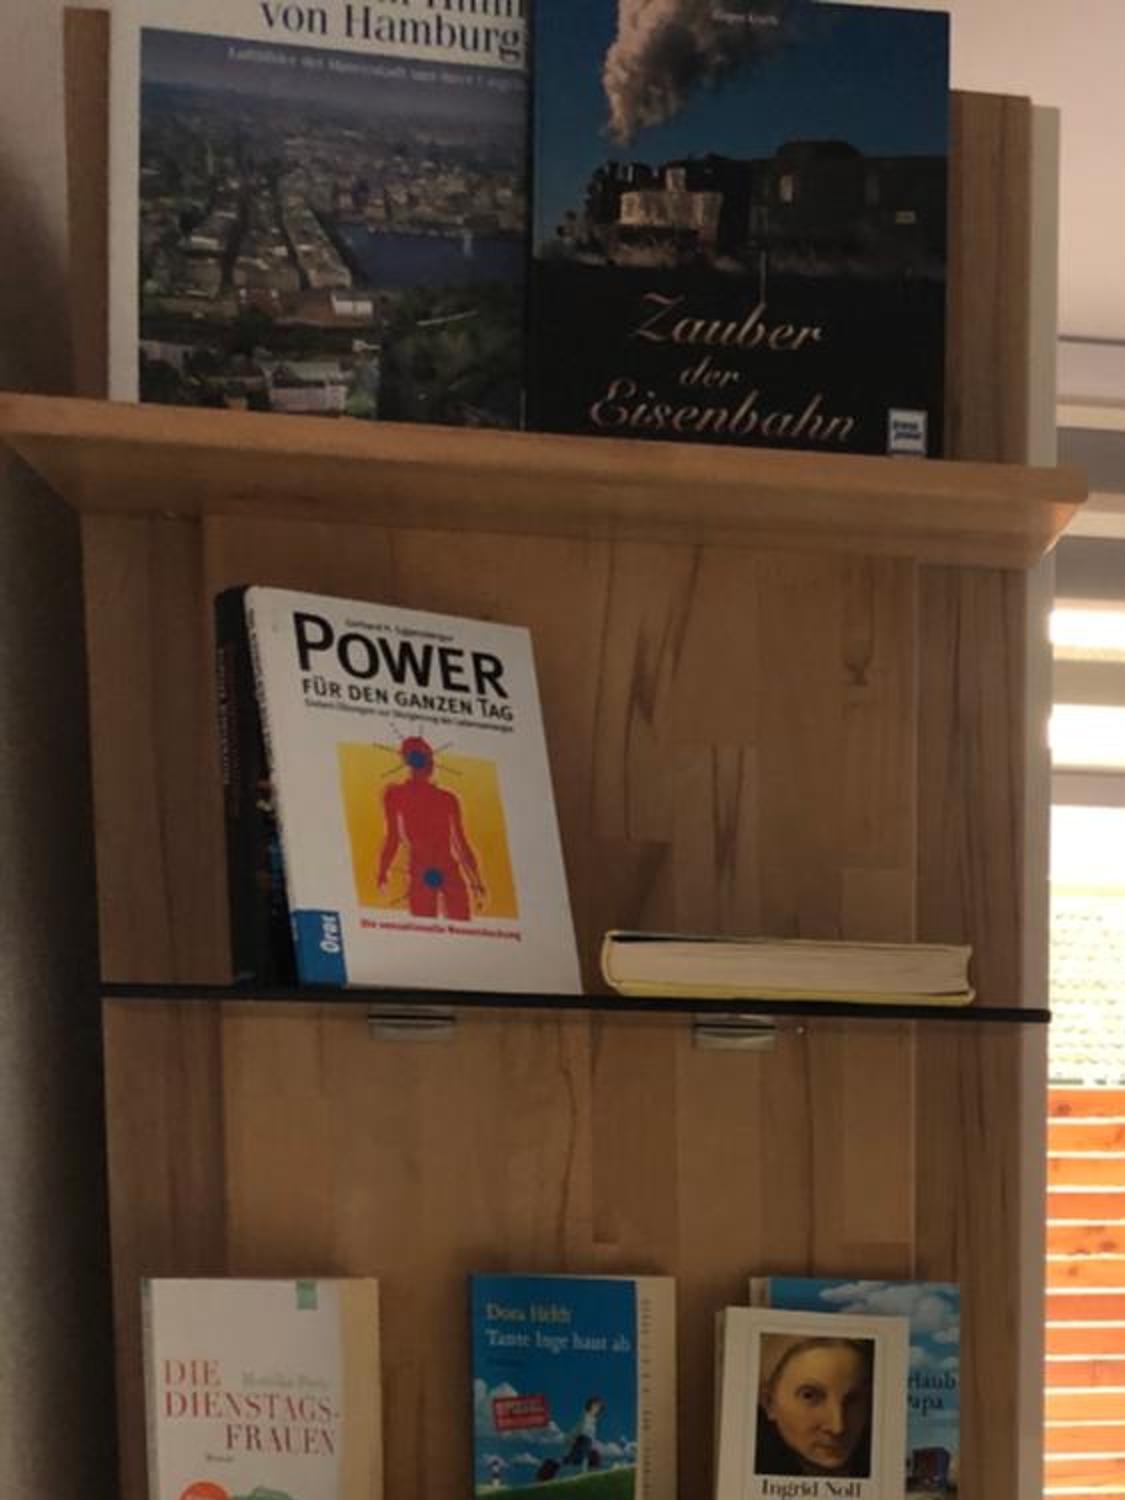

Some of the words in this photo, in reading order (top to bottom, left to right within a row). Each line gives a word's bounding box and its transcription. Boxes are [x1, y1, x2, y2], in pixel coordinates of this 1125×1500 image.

[258, 2, 328, 35] von
[345, 3, 522, 62] Hamburg
[630, 291, 823, 350] Zauber
[679, 355, 740, 387] der
[591, 379, 856, 442] Eisenbahn
[293, 611, 508, 699] POWER
[303, 676, 341, 697] FÜR
[348, 684, 389, 704] DEN
[394, 690, 473, 714] GANZEN
[477, 697, 513, 722] TAG
[485, 1328, 530, 1346] Tante
[611, 1333, 631, 1352] ab
[164, 1360, 221, 1386] DIE
[908, 1370, 956, 1390] rlaub
[908, 1394, 944, 1416] apa
[226, 1424, 336, 1455] FRAUEN
[762, 1479, 818, 1498] Ingrid
[826, 1481, 862, 1498] Noll
